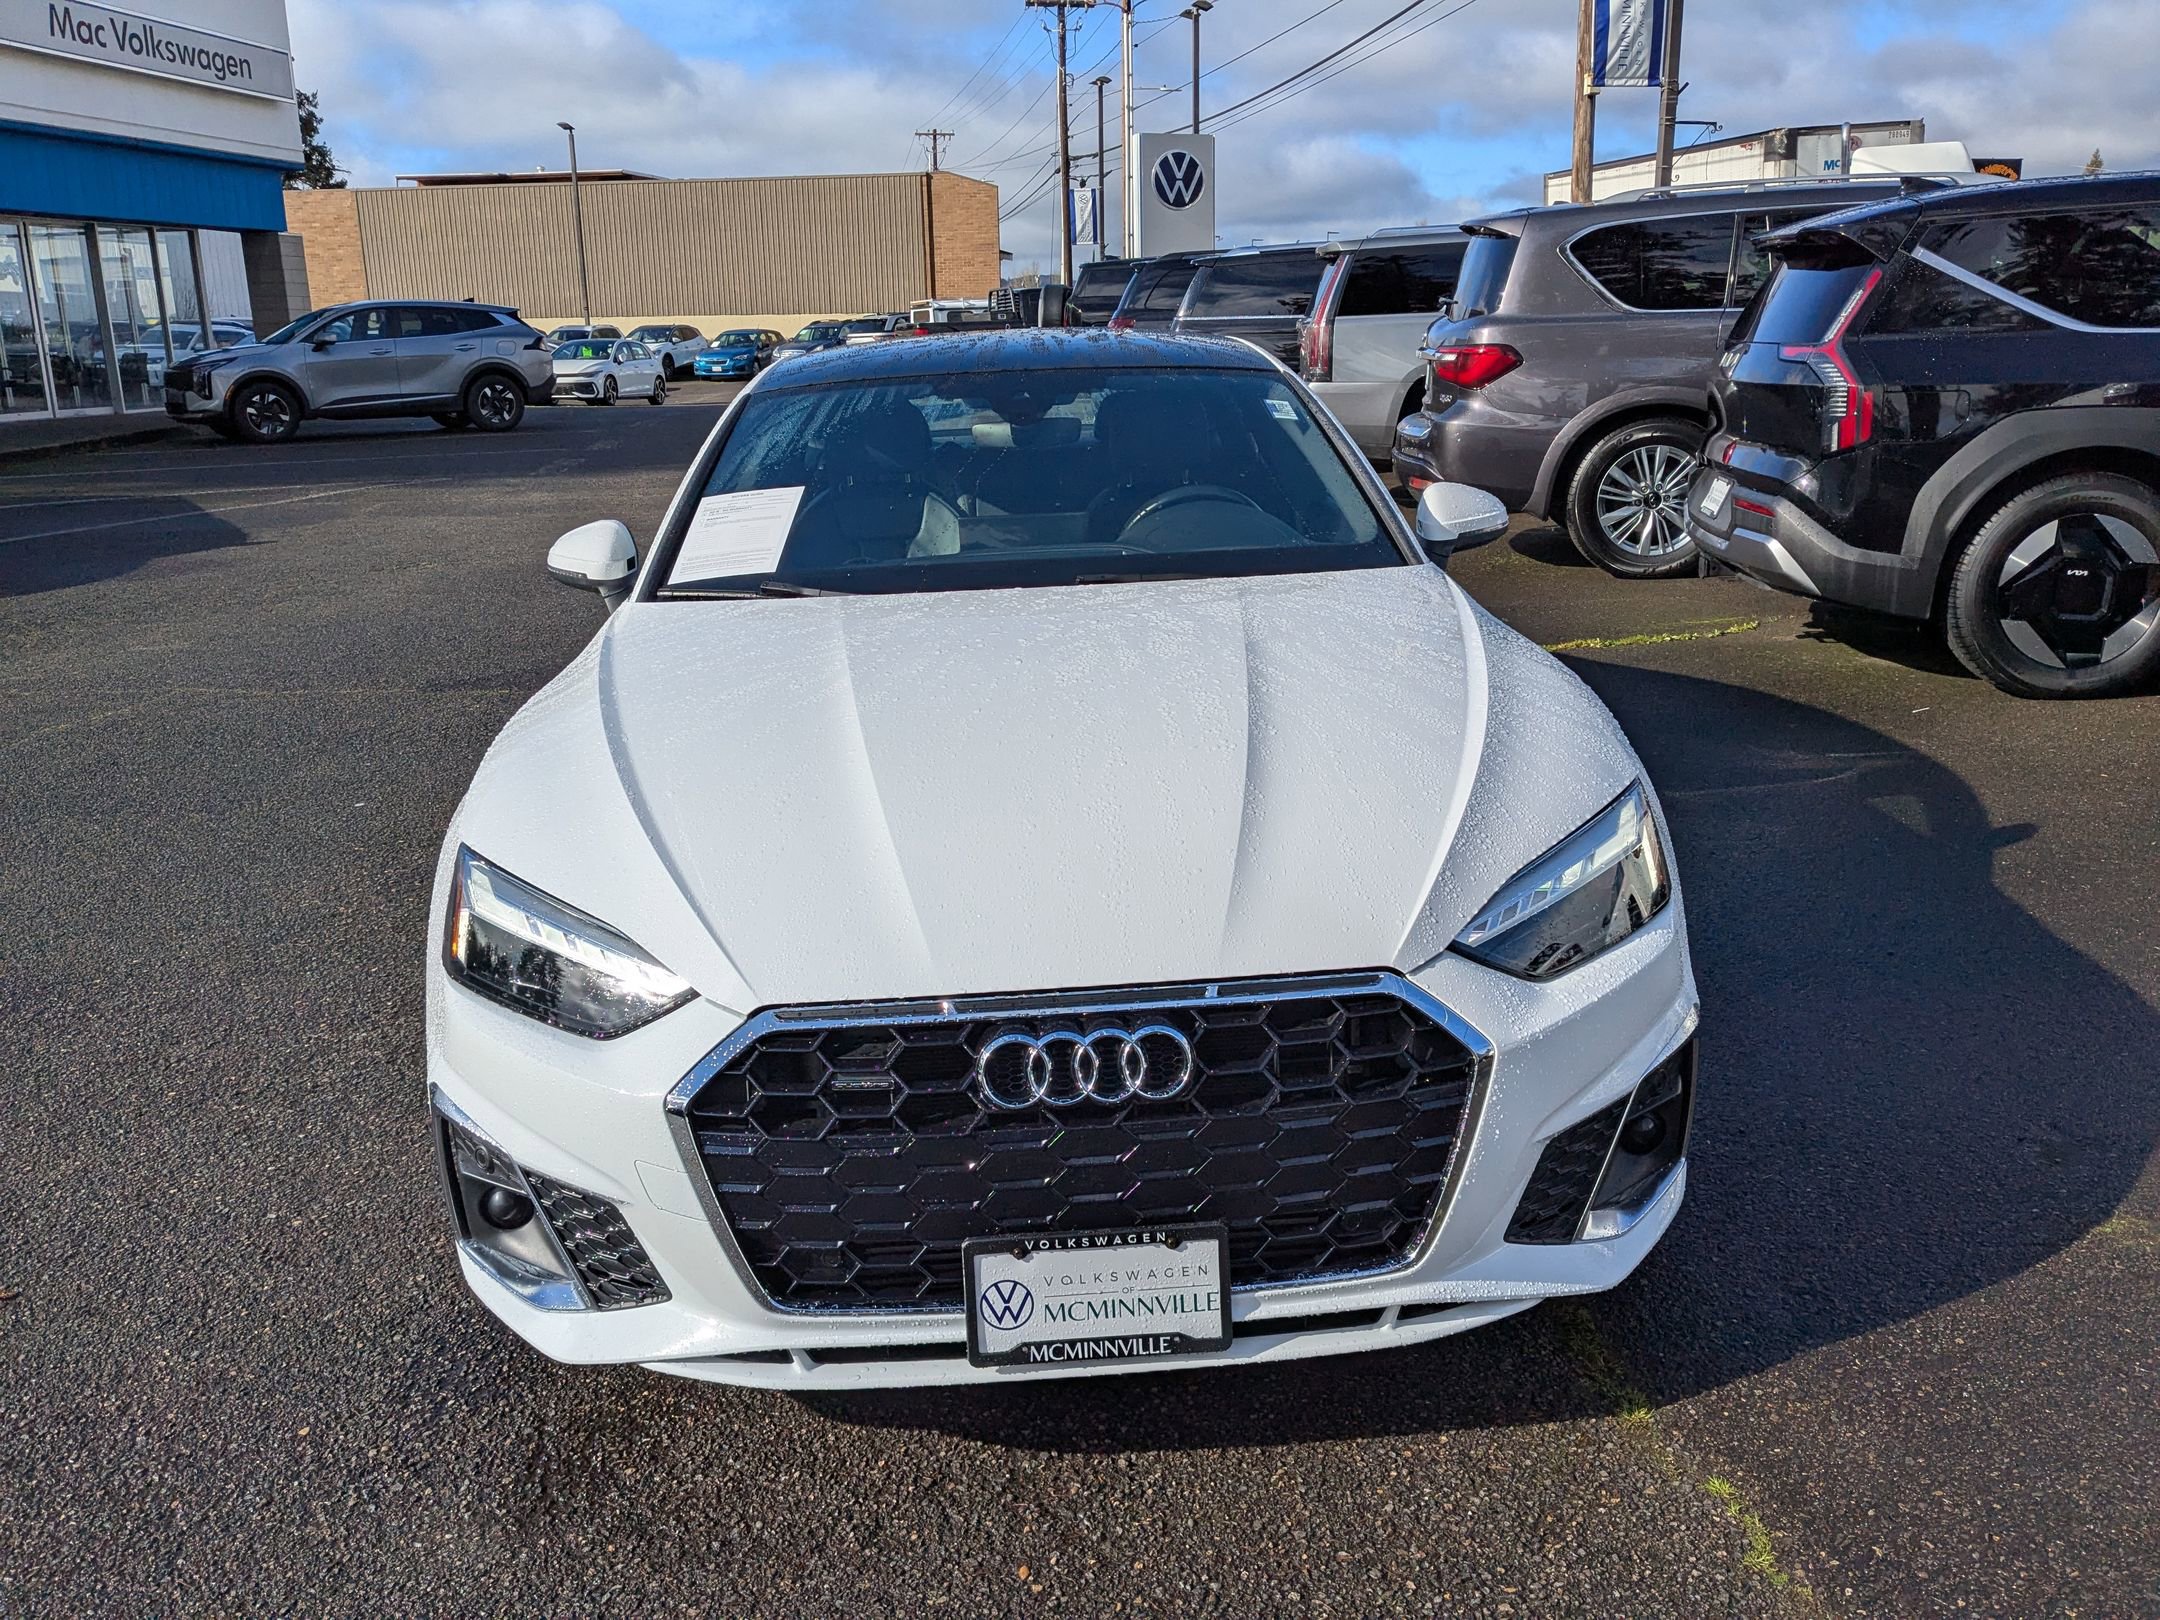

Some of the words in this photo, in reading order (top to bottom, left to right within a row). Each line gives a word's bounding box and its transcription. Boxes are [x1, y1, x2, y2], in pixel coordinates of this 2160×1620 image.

[50, 3, 107, 49] Mac
[108, 17, 253, 81] Volkswagen
[1024, 1231, 1167, 1250] VOLKSWAGEN
[1043, 1264, 1209, 1287] VOLKSWAGEN
[1121, 1286, 1136, 1294] OF
[1043, 1291, 1220, 1323] MCMINNVILLE
[1030, 1336, 1172, 1363] MCMINNVILLE
